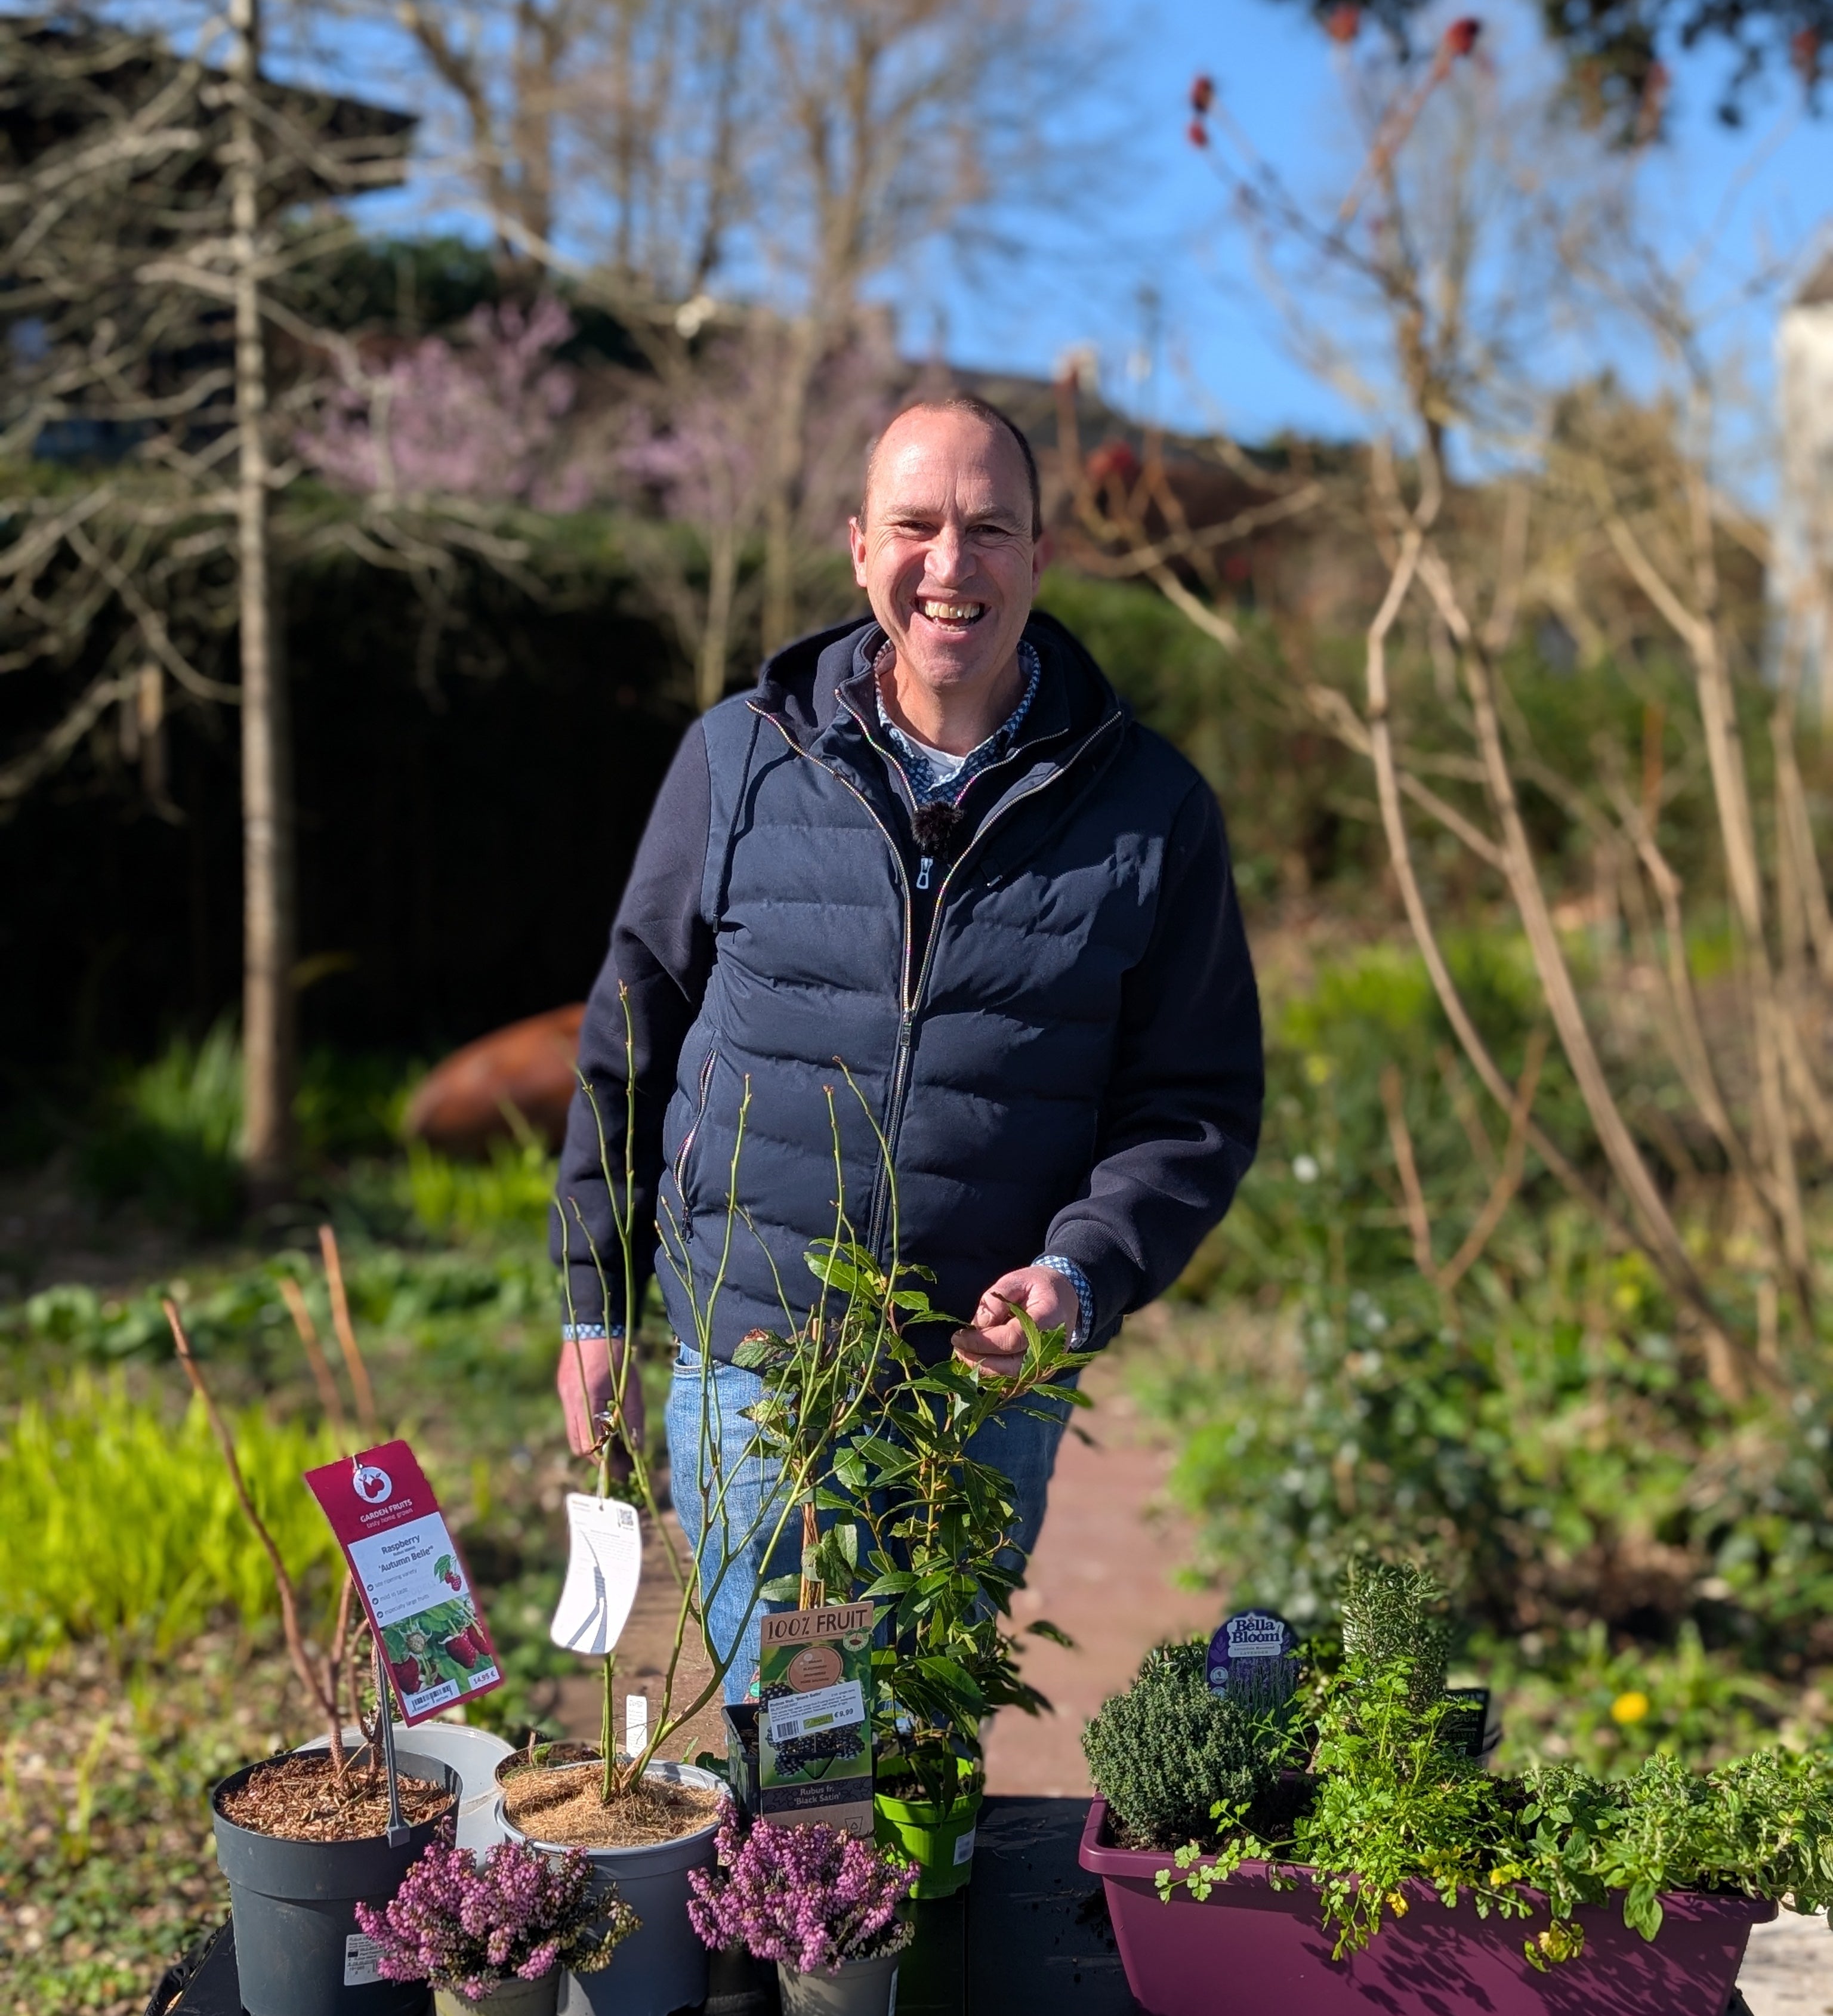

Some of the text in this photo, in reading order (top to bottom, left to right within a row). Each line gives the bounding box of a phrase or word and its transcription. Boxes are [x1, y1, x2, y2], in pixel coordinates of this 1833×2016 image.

[360, 1499, 413, 1523] GARDEN FRUITS
[380, 1514, 396, 1523] home
[396, 1508, 413, 1518] grown
[381, 1535, 420, 1555] Raspberry
[402, 1569, 418, 1578] variety
[767, 1609, 868, 1640] 100% FRUIT
[1235, 1619, 1275, 1632] Bella
[1231, 1631, 1280, 1644] Bloom
[800, 1786, 825, 1796] Rubus
[794, 1792, 841, 1805] 'Black Satin'
